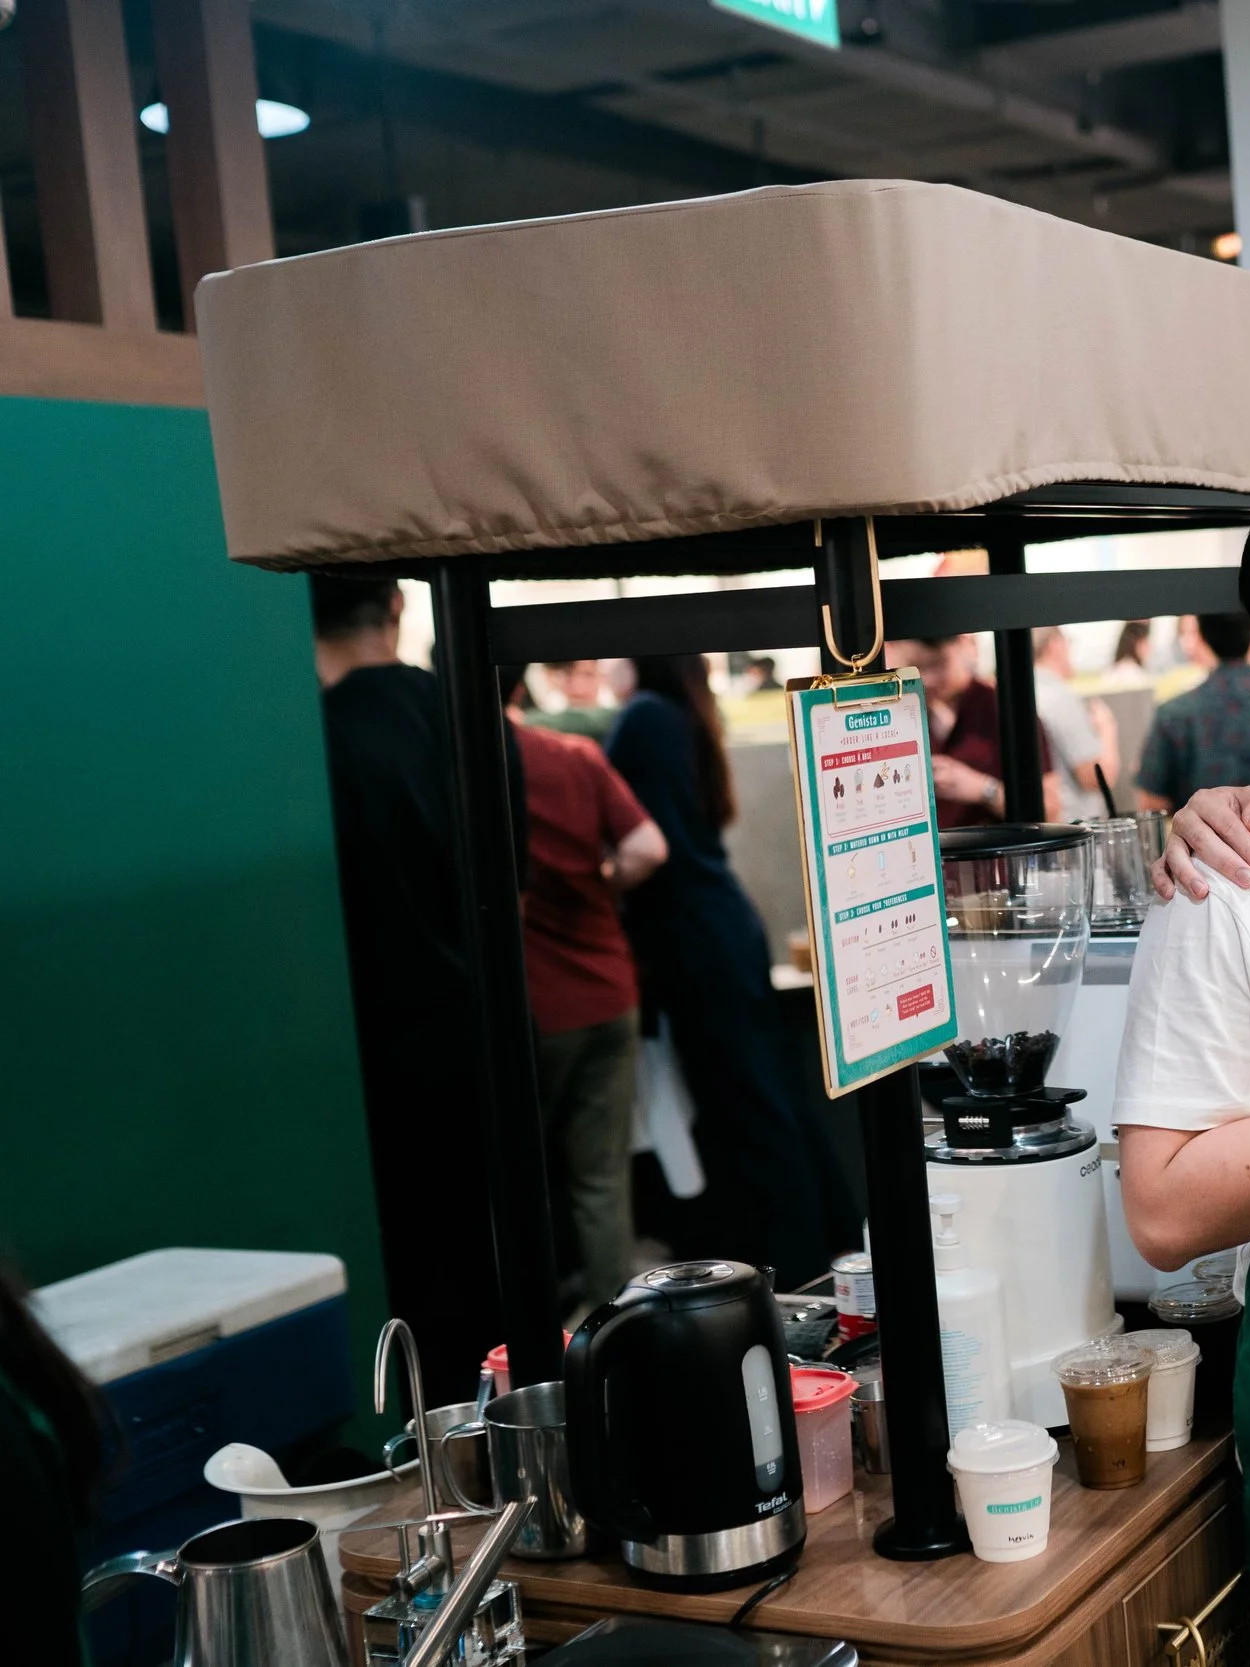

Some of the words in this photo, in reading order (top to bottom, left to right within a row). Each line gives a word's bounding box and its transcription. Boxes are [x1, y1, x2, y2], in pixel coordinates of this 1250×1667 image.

[848, 715, 877, 729] Genista
[879, 712, 889, 725] Ln
[824, 758, 834, 767] STEP
[841, 755, 856, 764] CHOOSE
[832, 845, 842, 854] STEP
[887, 830, 897, 840] WITH
[839, 910, 849, 920] STEP
[755, 1491, 788, 1514] Tefal
